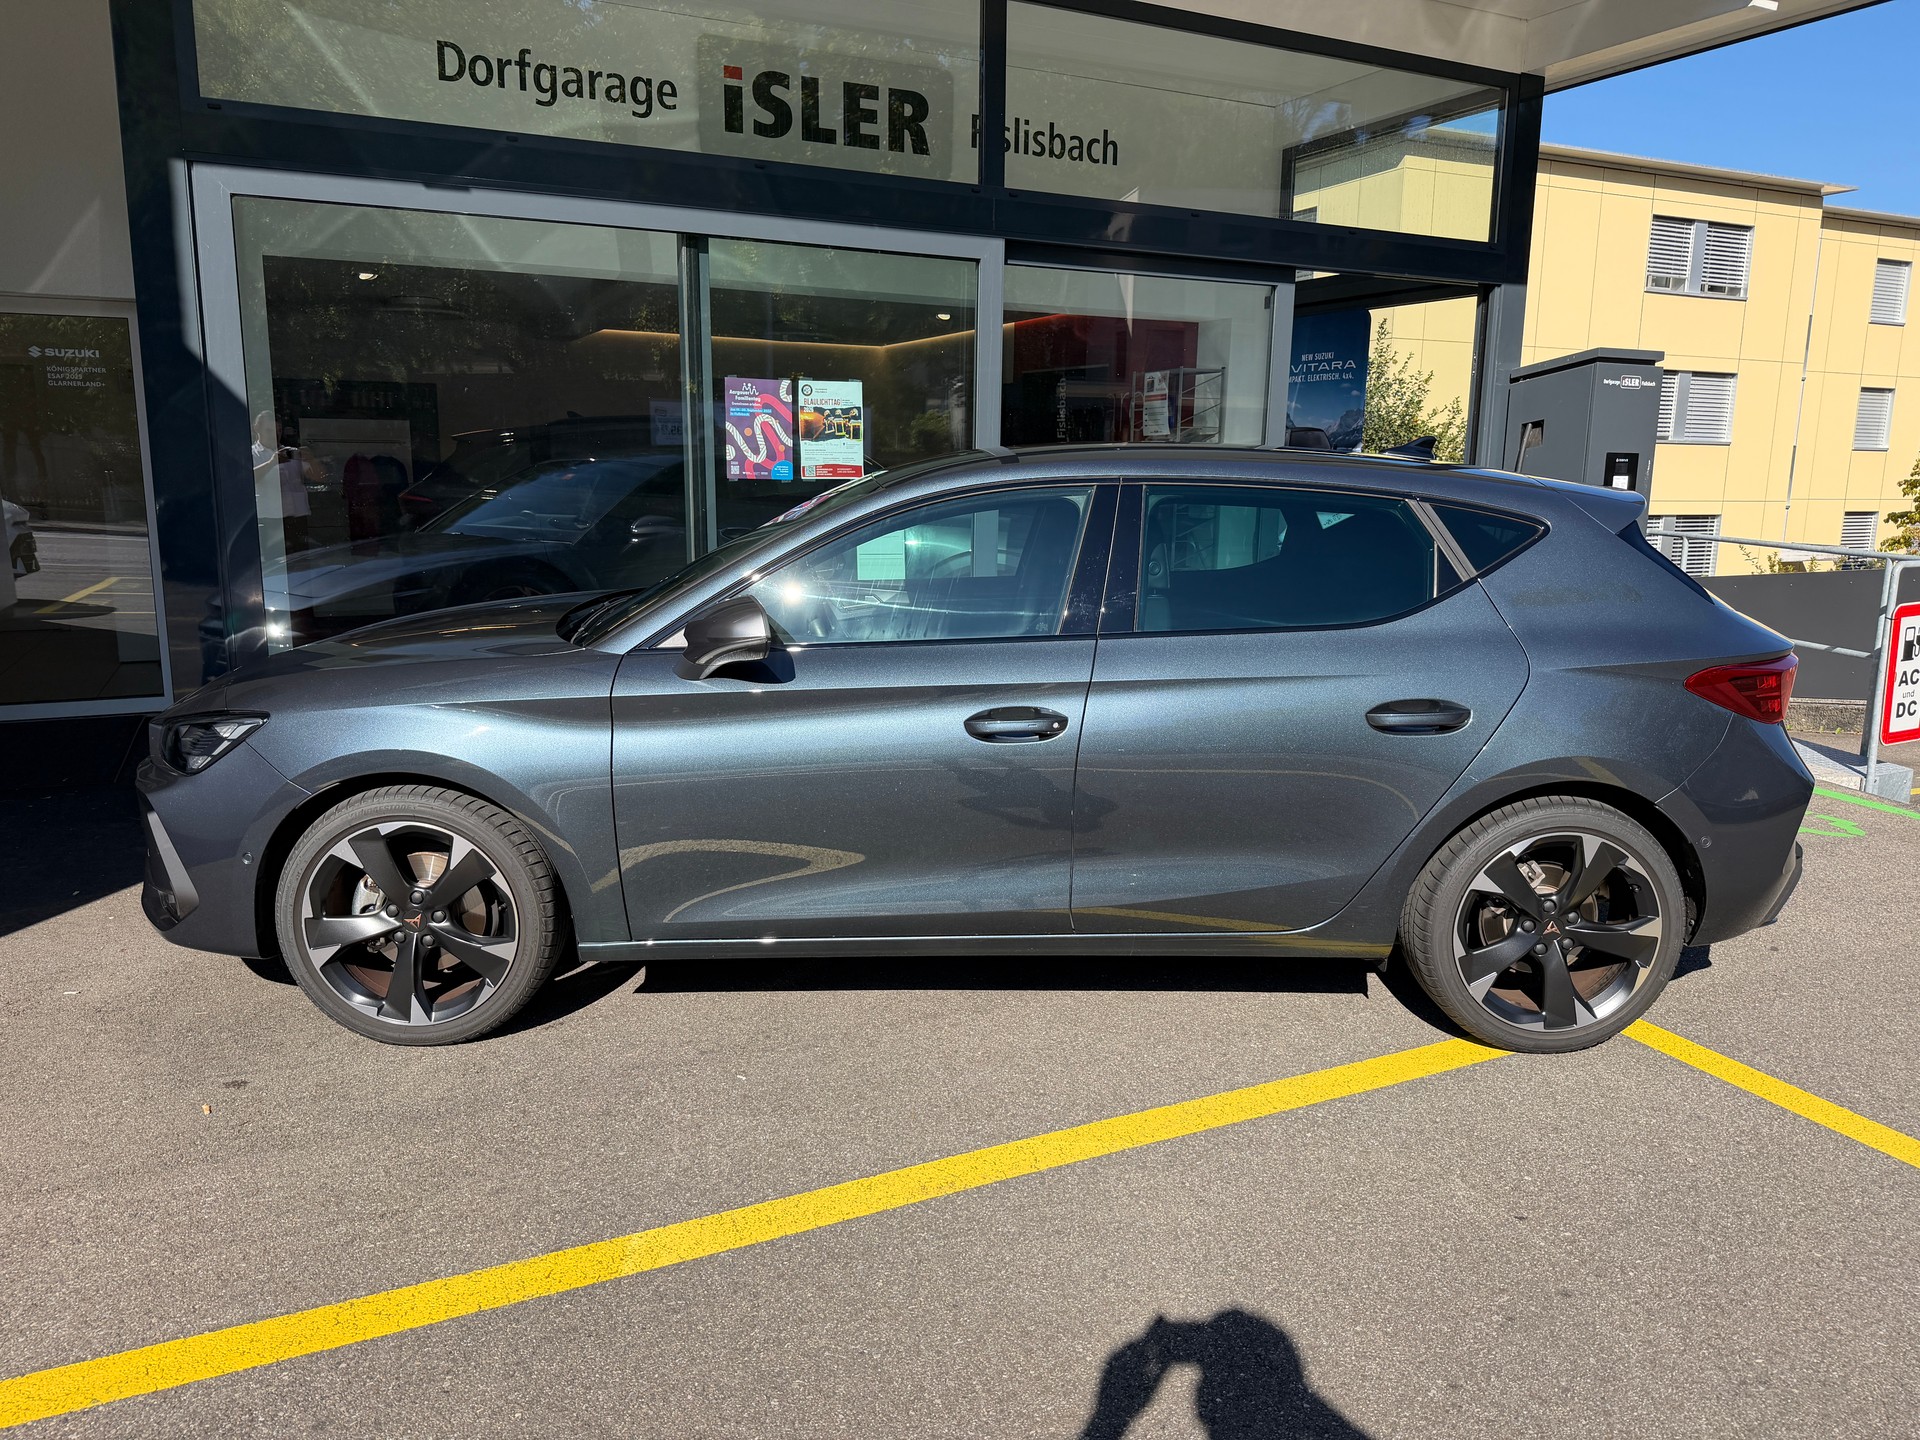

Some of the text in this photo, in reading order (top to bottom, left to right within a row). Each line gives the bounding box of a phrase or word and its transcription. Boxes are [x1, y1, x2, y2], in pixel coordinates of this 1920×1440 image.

[436, 40, 1118, 166] Dorfgarage iSLER Fslisbach
[44, 348, 100, 358] SUZUKI
[1301, 352, 1334, 361] NEW SUZUKI
[46, 365, 107, 373] KÖNIGSPARTNER
[1291, 359, 1356, 373] VITARA
[803, 398, 841, 406] BLAULICHTTAG
[1057, 377, 1067, 439] Fislisbach
[1898, 669, 1920, 687] AC
[1902, 689, 1915, 699] und
[1896, 700, 1917, 718] DC
